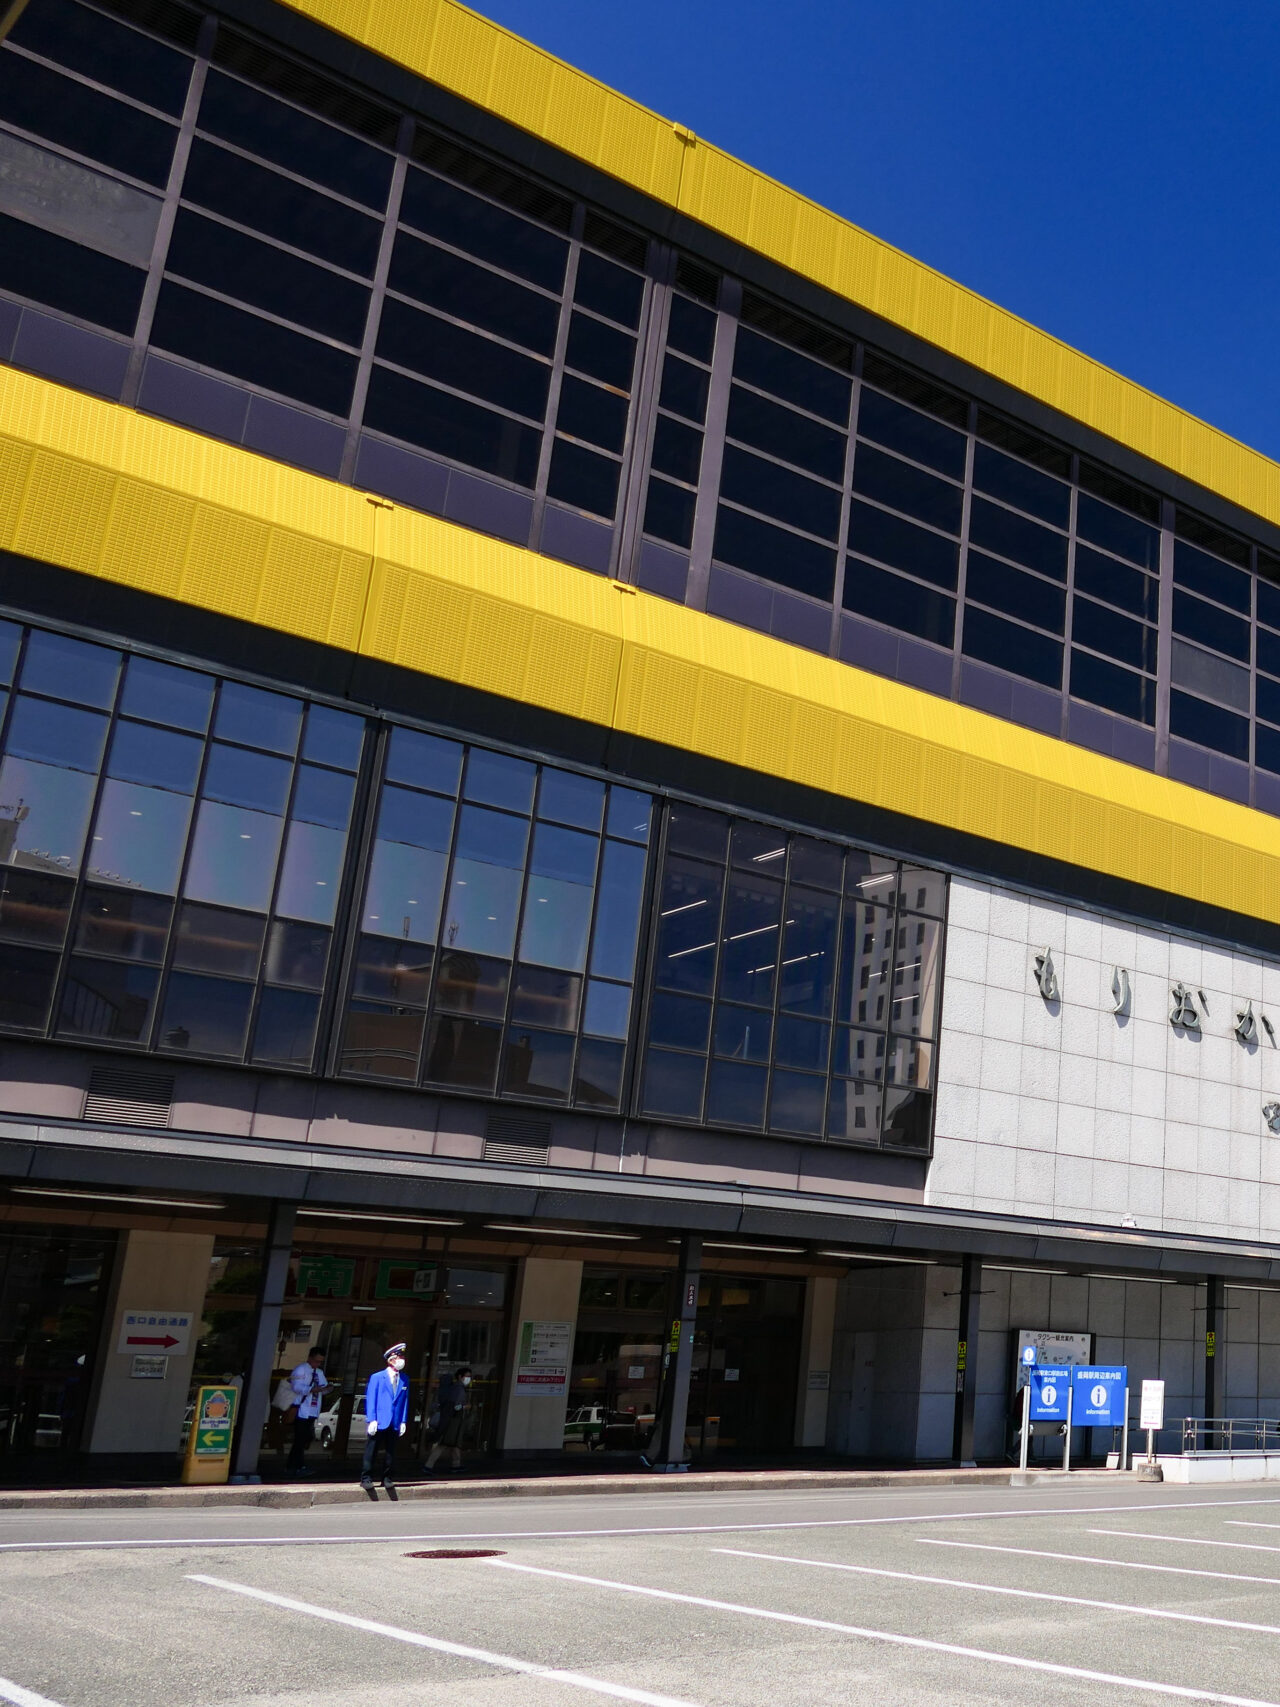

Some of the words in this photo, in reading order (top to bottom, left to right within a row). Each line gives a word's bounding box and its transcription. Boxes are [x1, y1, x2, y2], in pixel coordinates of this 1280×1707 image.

[296, 1255, 438, 1301] 南口
[127, 1316, 189, 1327] 西口自由通路
[1077, 1371, 1122, 1380] 盛岡駅周辺案内図
